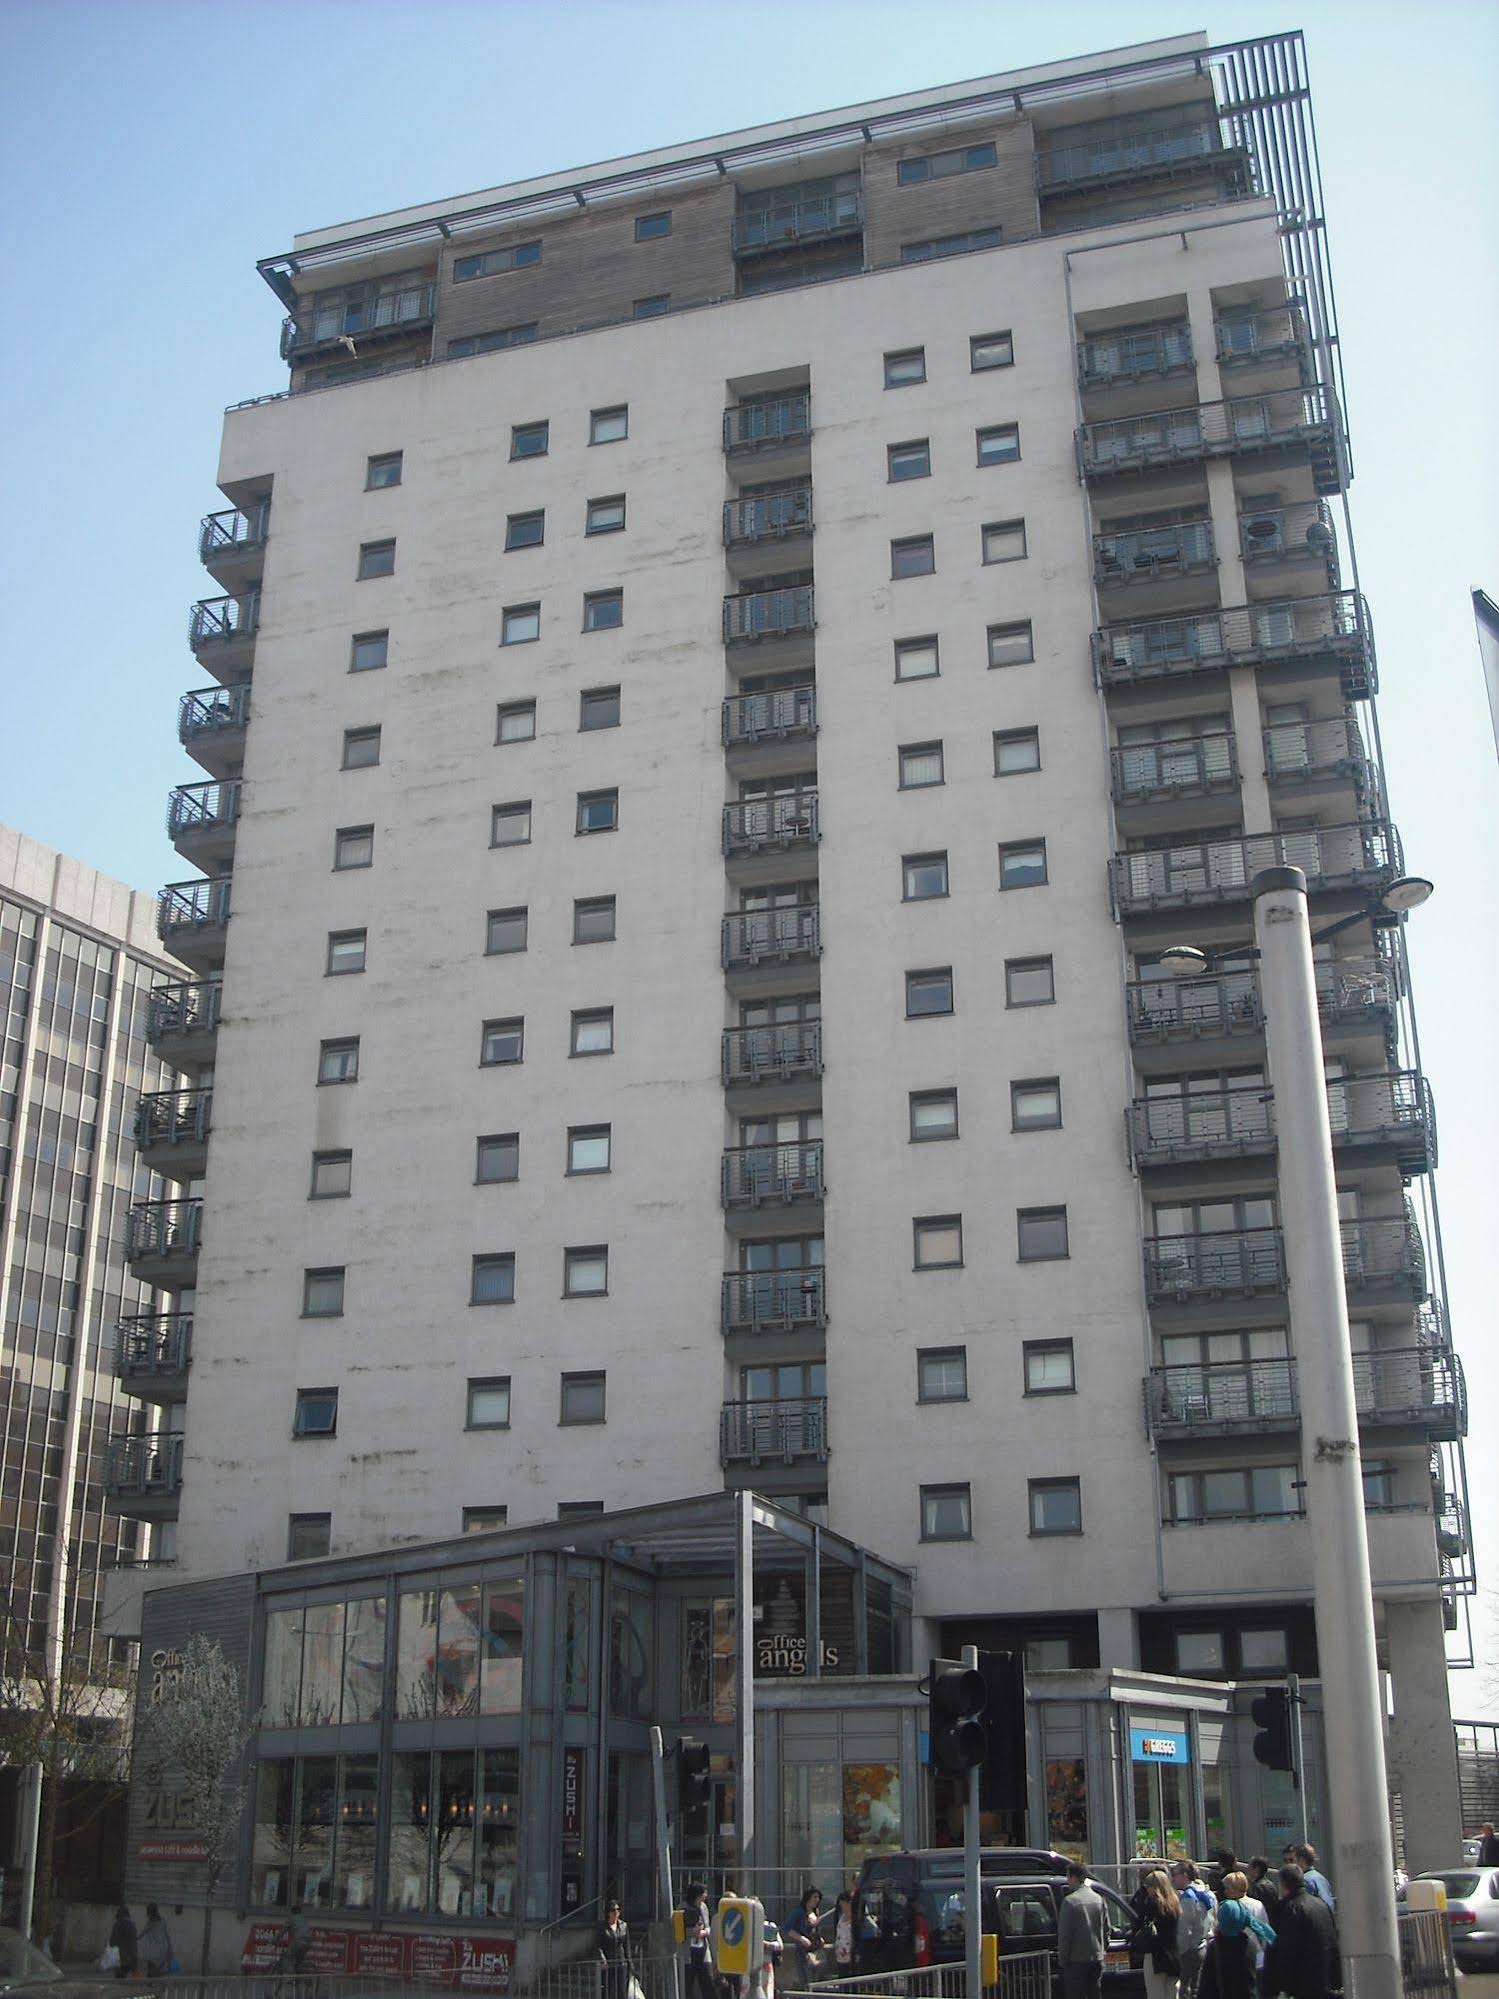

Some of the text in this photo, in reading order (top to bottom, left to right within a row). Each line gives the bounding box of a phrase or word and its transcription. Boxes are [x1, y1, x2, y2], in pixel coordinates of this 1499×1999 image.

[757, 1634, 805, 1649] office
[760, 1639, 839, 1675] angls
[1150, 1738, 1176, 1754] GREGGS
[566, 1766, 577, 1829] ZUSHI
[462, 1951, 509, 1972] ZUSHI
